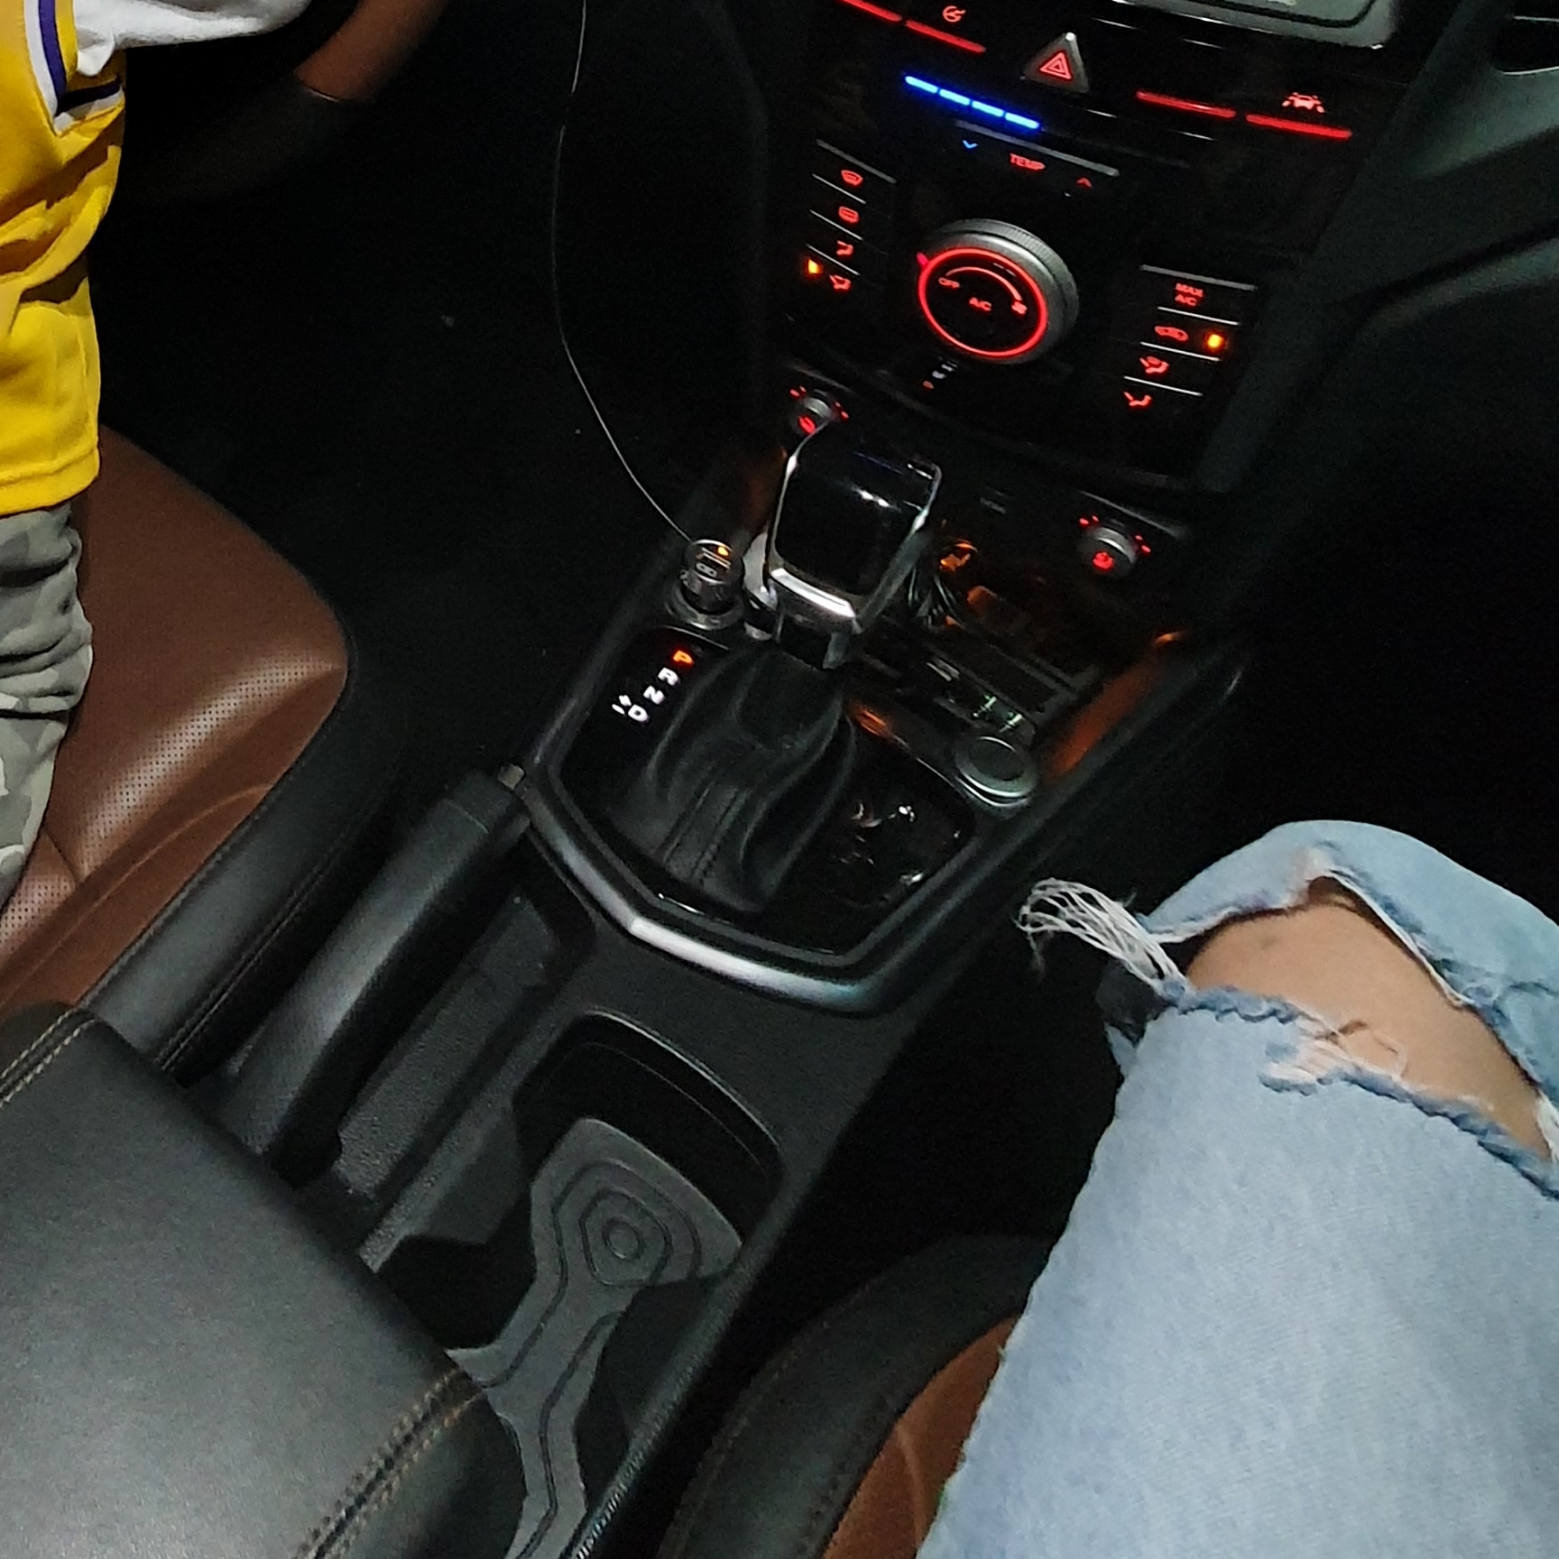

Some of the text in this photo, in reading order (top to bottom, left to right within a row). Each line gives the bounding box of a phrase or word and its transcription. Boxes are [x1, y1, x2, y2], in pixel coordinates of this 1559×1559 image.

[1010, 153, 1045, 171] TEMP
[969, 297, 992, 312] A/C
[673, 650, 693, 664] P
[658, 667, 679, 686] R
[643, 685, 664, 705] N
[628, 704, 648, 722] D
